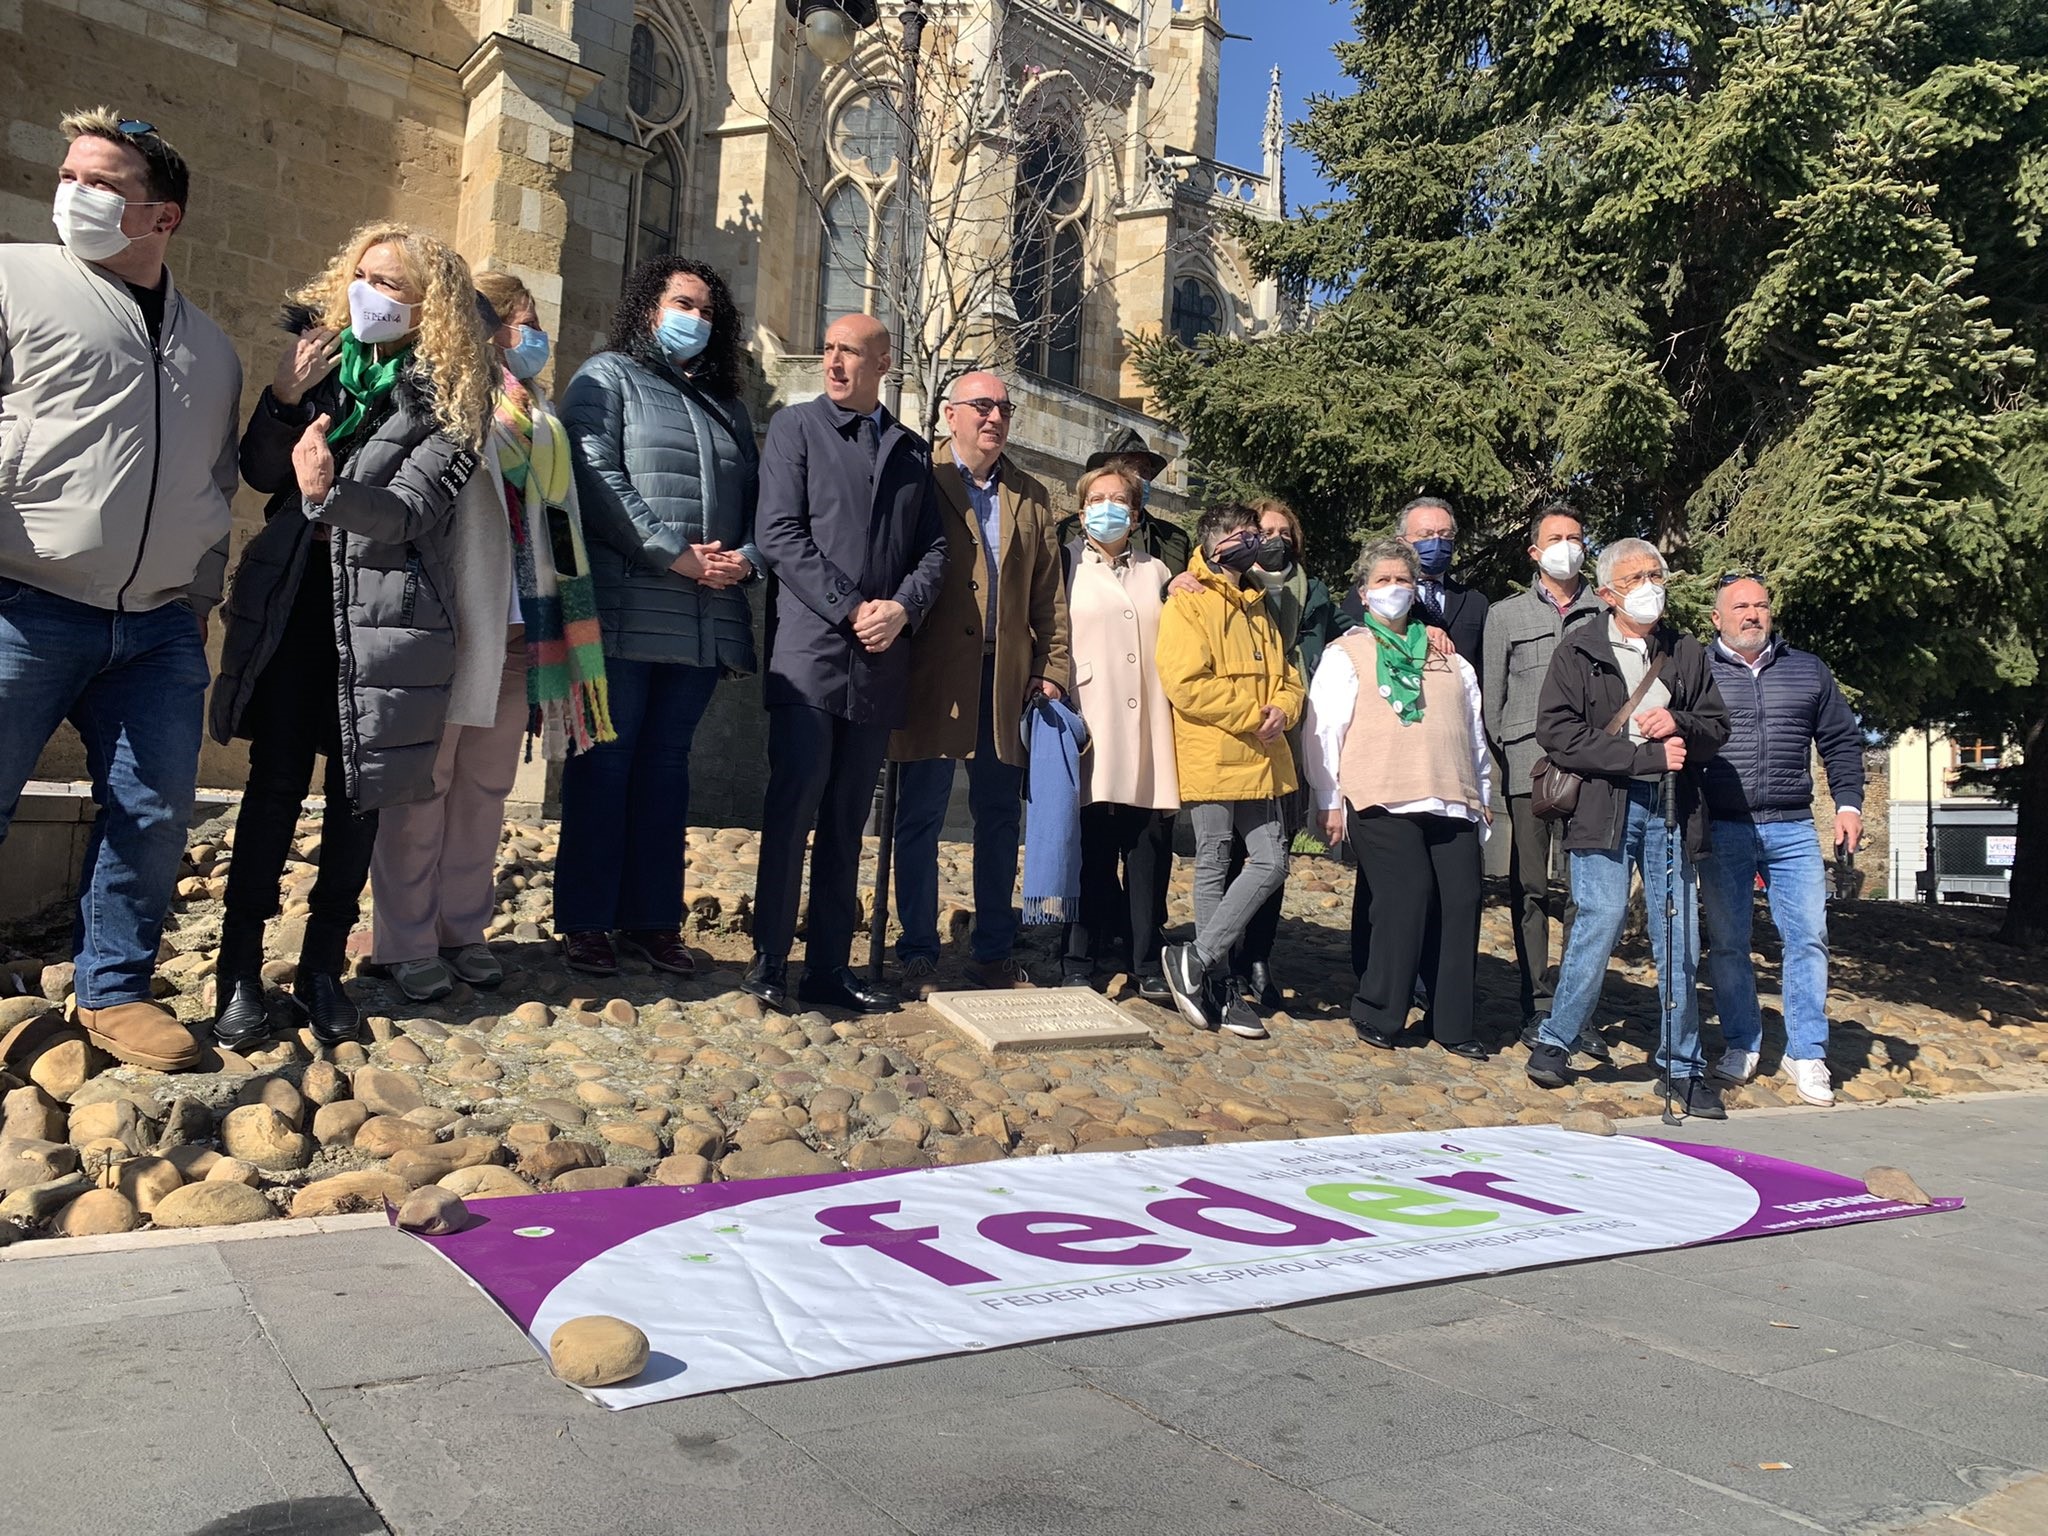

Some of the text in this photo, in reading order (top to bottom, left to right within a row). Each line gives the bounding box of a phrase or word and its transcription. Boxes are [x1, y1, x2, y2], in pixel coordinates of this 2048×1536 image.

[1279, 1147, 1418, 1165] entidad de
[1247, 1159, 1455, 1180] utilidad pública
[1772, 1193, 1891, 1213] ESPERANZ
[814, 1171, 1584, 1287] feder
[980, 1219, 1638, 1311] FEDERACIÓN ESPAÑOLA DE ENFERMEDADES RARAS
